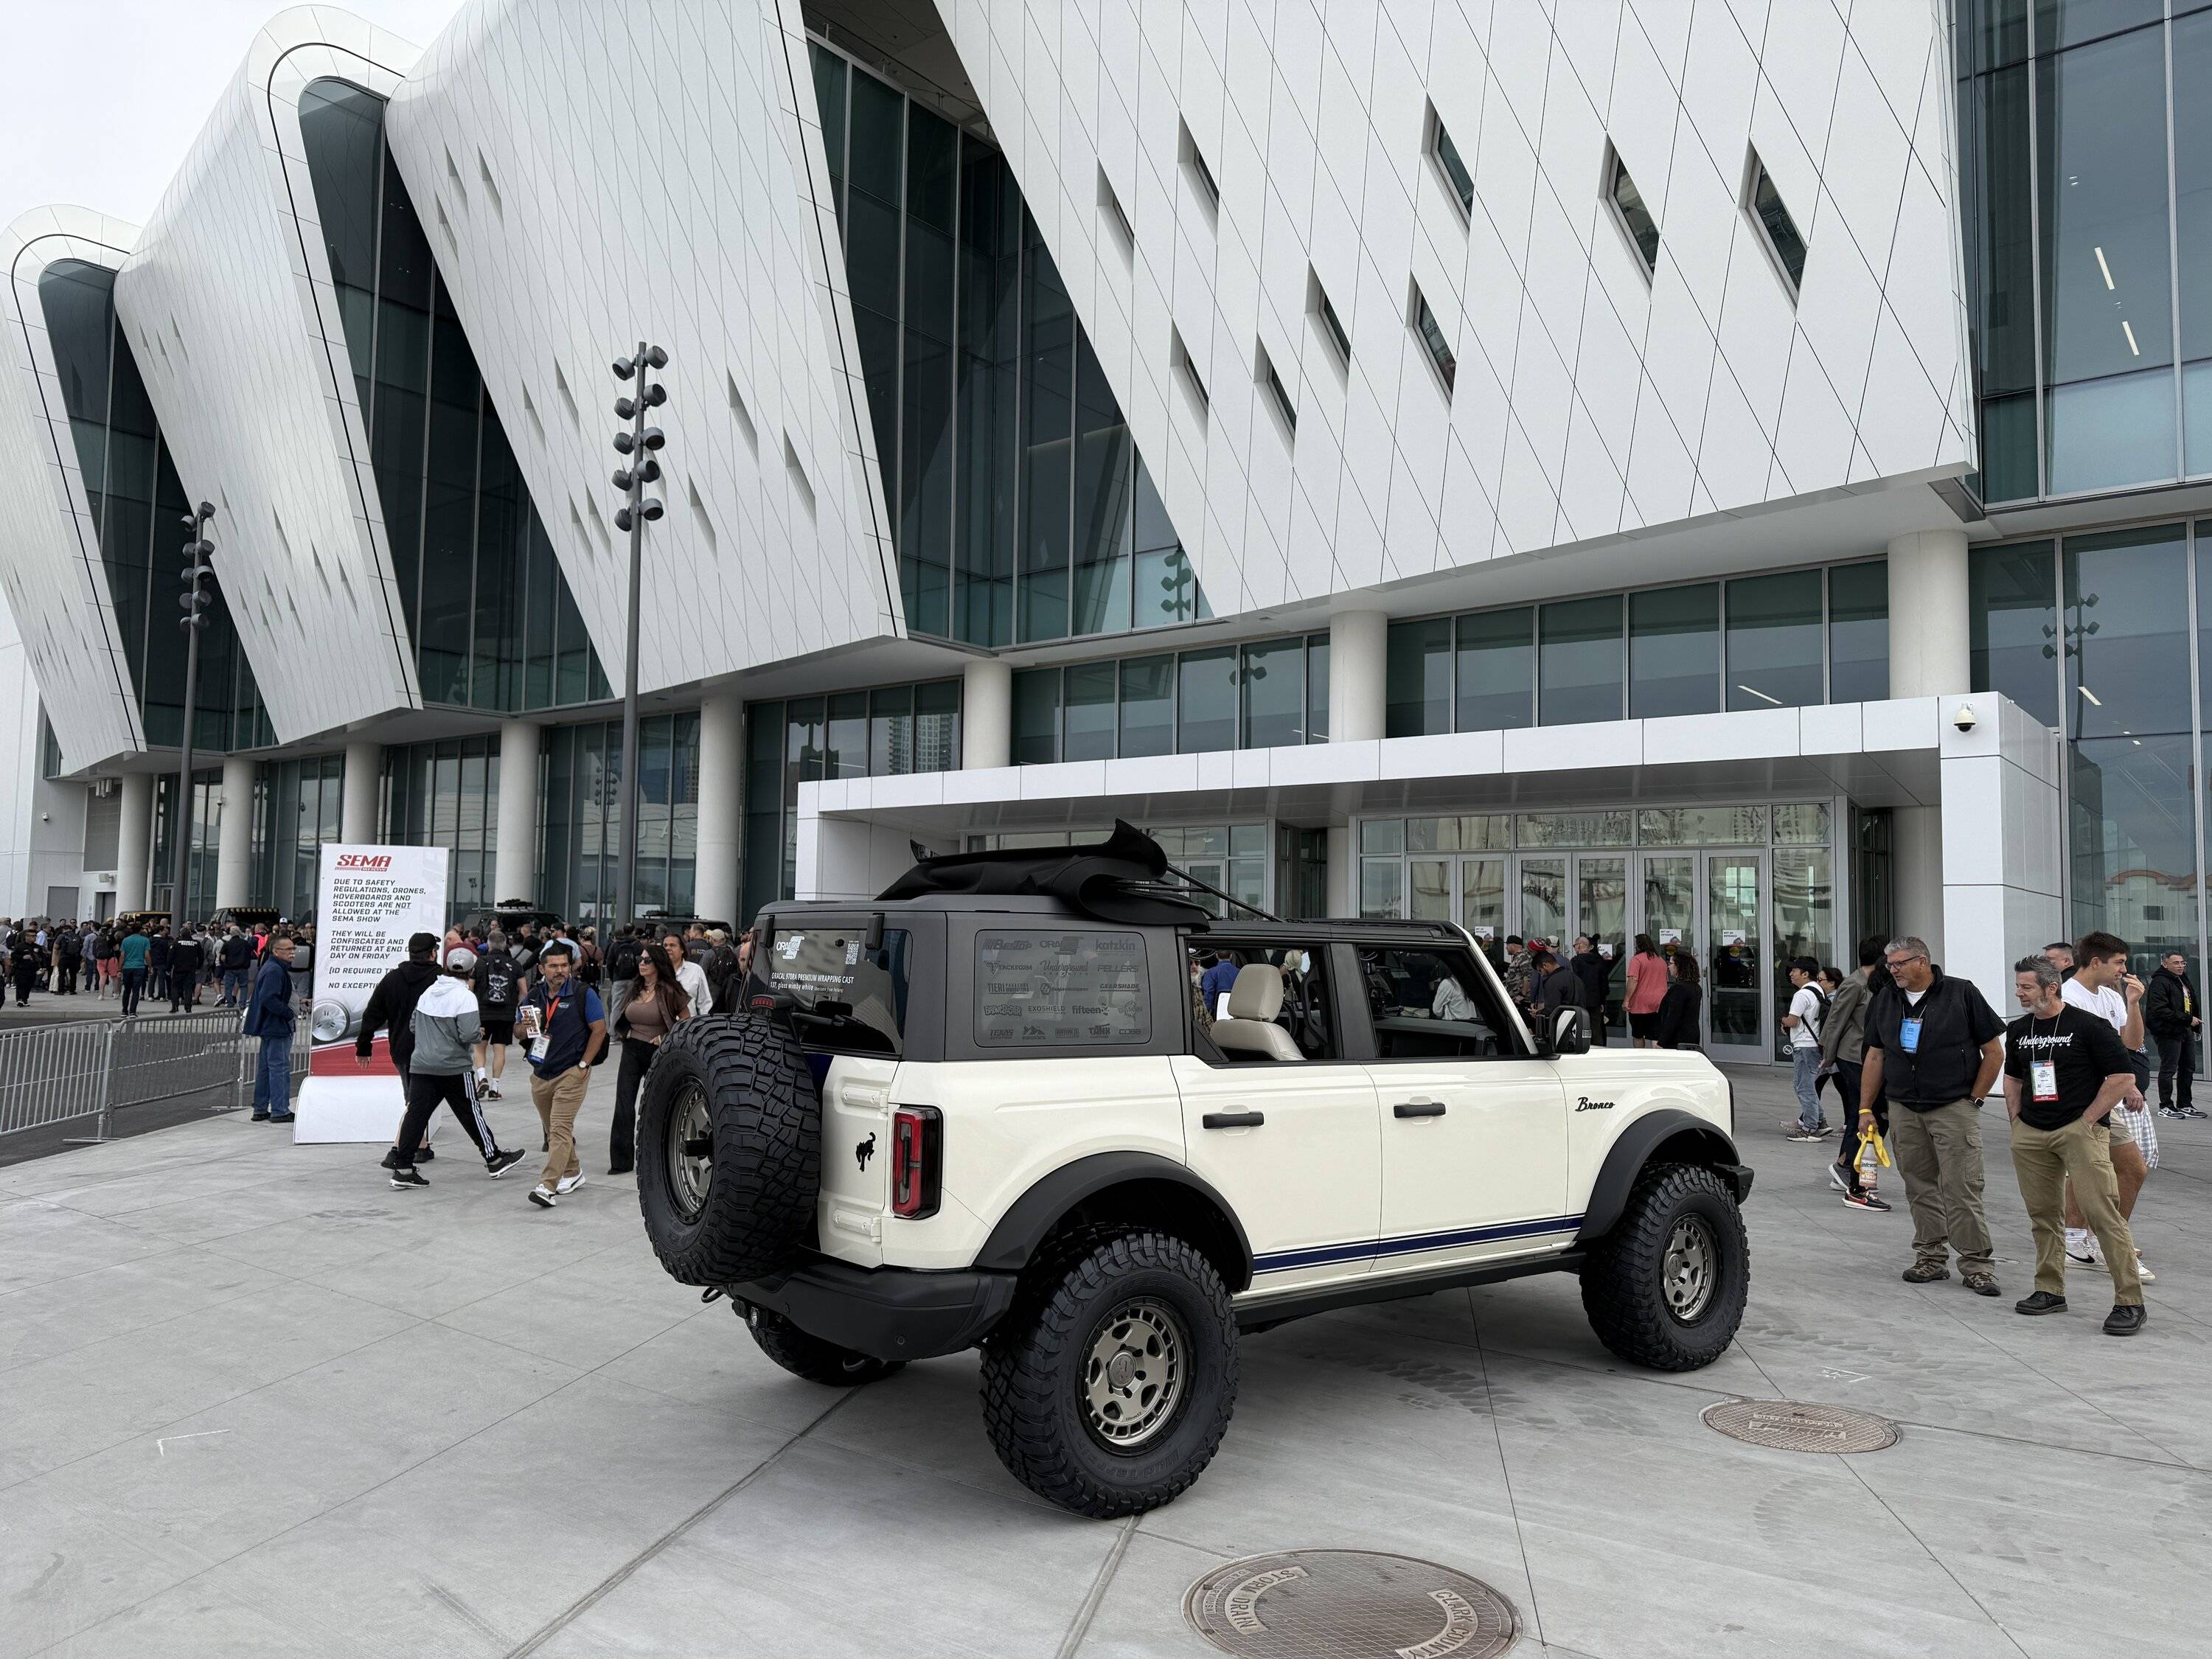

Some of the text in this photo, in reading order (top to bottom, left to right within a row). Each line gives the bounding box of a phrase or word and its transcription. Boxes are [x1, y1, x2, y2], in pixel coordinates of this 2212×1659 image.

[337, 855, 392, 867] SEMA
[1095, 939, 1135, 950] katzkin
[798, 973, 817, 981] PREMIUM
[818, 974, 841, 984] WRAPPING
[2019, 1033, 2073, 1050] Underground
[1575, 1096, 1615, 1112] Bronco
[1230, 1570, 1295, 1629] STORM DRAIN
[1408, 1592, 1473, 1659] CLARK COUNTY
